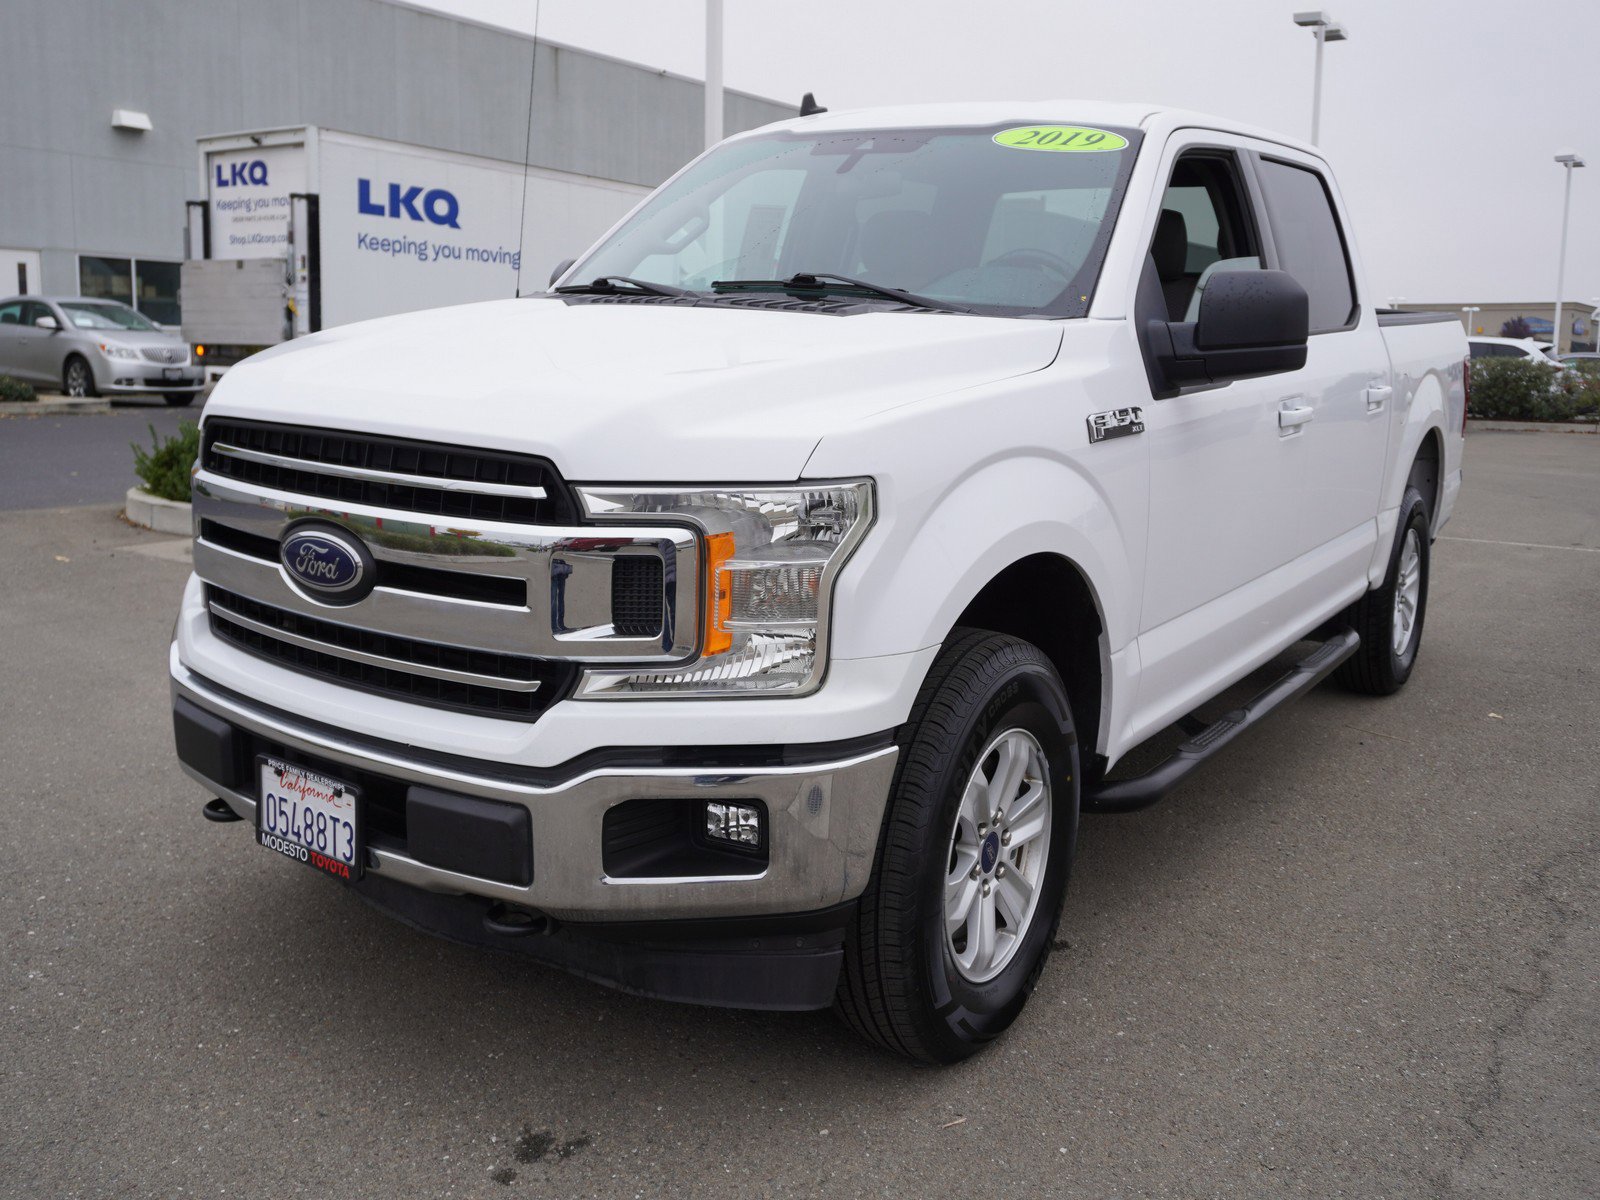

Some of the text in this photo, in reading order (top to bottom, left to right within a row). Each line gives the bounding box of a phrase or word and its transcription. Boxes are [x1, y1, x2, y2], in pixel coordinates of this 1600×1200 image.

[1012, 130, 1106, 147] 2019
[216, 160, 269, 188] LKQ
[216, 196, 291, 213] Keeping you mov
[358, 178, 461, 229] LKQ
[229, 233, 289, 247] Shop.LKQcorp.co
[357, 233, 521, 270] Keeping you moving
[1132, 424, 1143, 432] XLT
[295, 542, 341, 580] Ford
[285, 764, 306, 779] FAMLY
[280, 770, 342, 808] California
[266, 792, 354, 862] 05488T3
[261, 832, 350, 880] MODESTO TOYOTA
